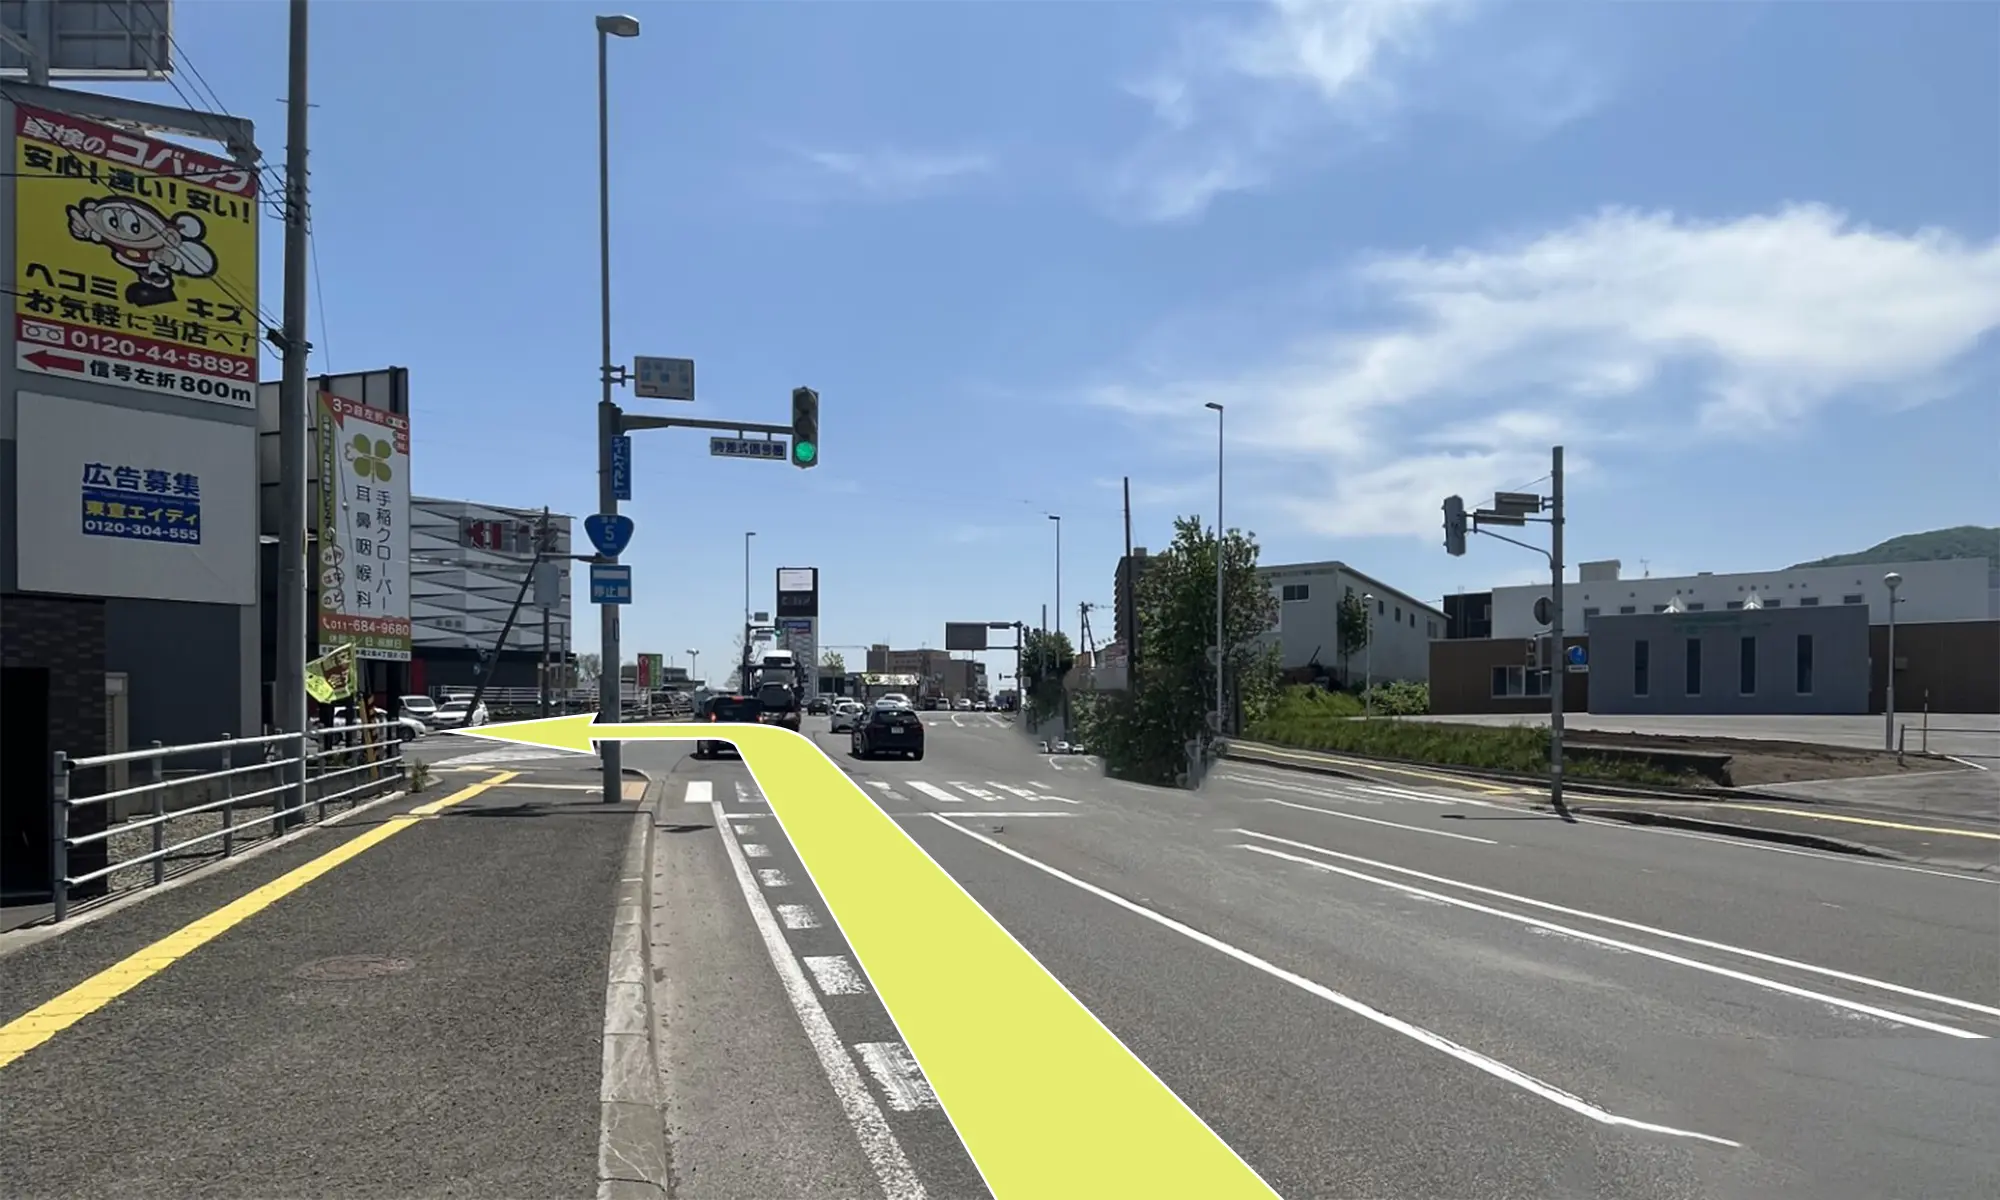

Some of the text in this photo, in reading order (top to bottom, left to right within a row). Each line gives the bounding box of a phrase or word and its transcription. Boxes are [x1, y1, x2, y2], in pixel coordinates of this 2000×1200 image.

[23, 116, 250, 192] 車検のコバック
[26, 262, 118, 300] ヘコミ
[186, 297, 244, 325] キズ
[71, 330, 250, 378] 0120-44-5892
[90, 359, 251, 402] 信号左折800m
[83, 462, 200, 496] 広告募集
[85, 520, 198, 540] 0120-304-555
[356, 485, 372, 608] 耳鼻咽喉科
[605, 525, 615, 541] 5
[376, 490, 392, 610] 手稲クローバー
[594, 584, 628, 598] 停止
[330, 619, 409, 636] 011-684-9680
